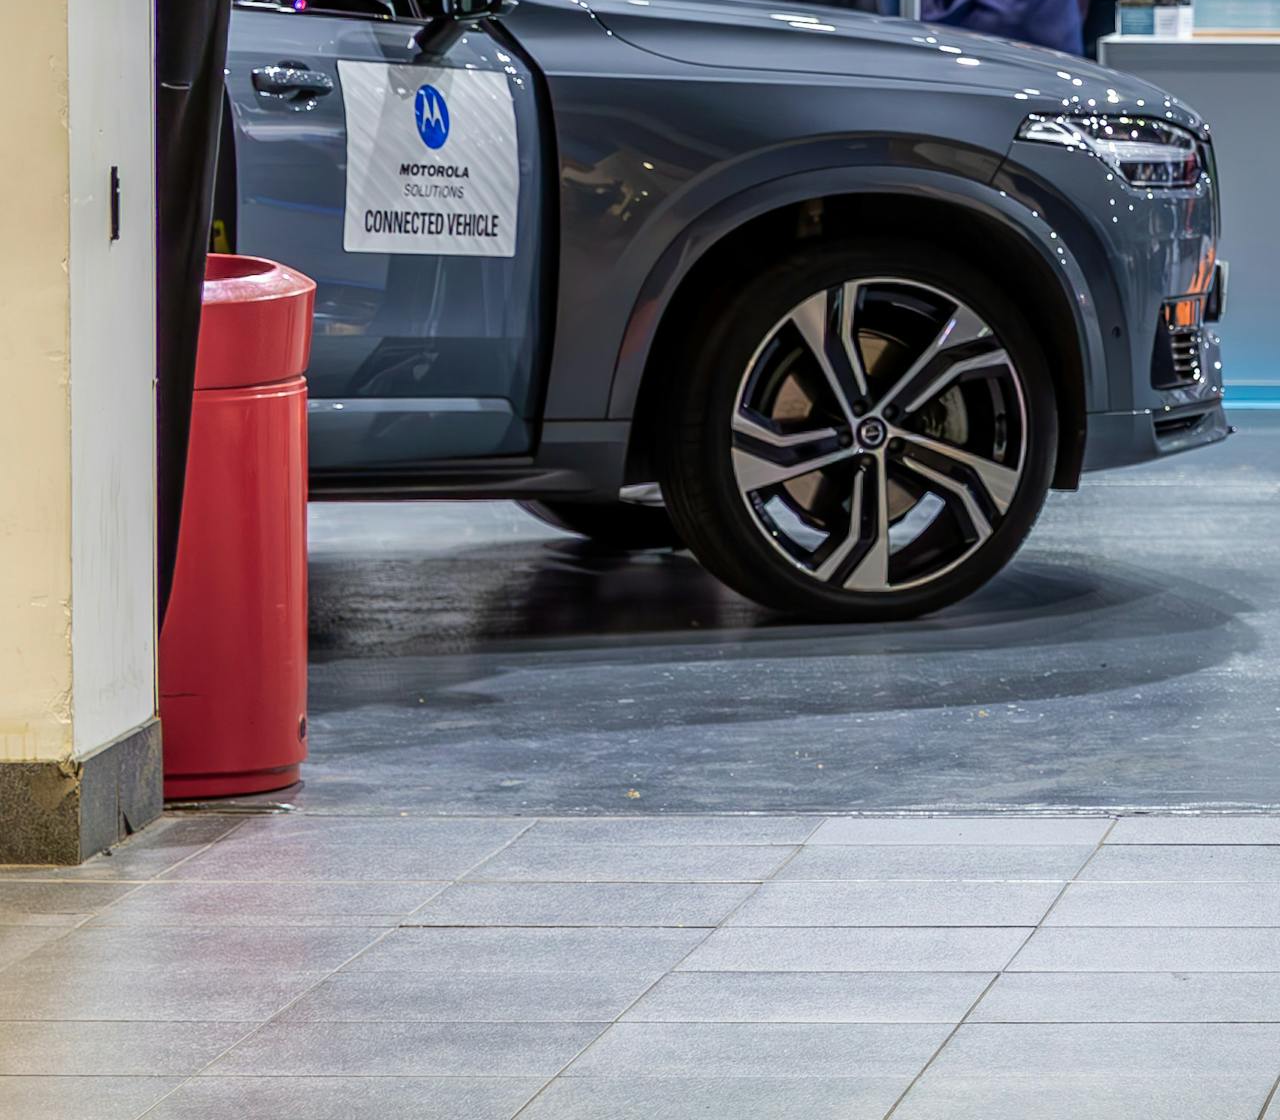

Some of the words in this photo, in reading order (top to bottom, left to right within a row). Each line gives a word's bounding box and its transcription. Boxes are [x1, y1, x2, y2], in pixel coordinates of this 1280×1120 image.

[399, 162, 470, 179] MOTOROLA
[403, 182, 465, 200] SOLUTIONS
[364, 208, 444, 236] CONNECTED
[446, 212, 500, 238] VEHICLE
